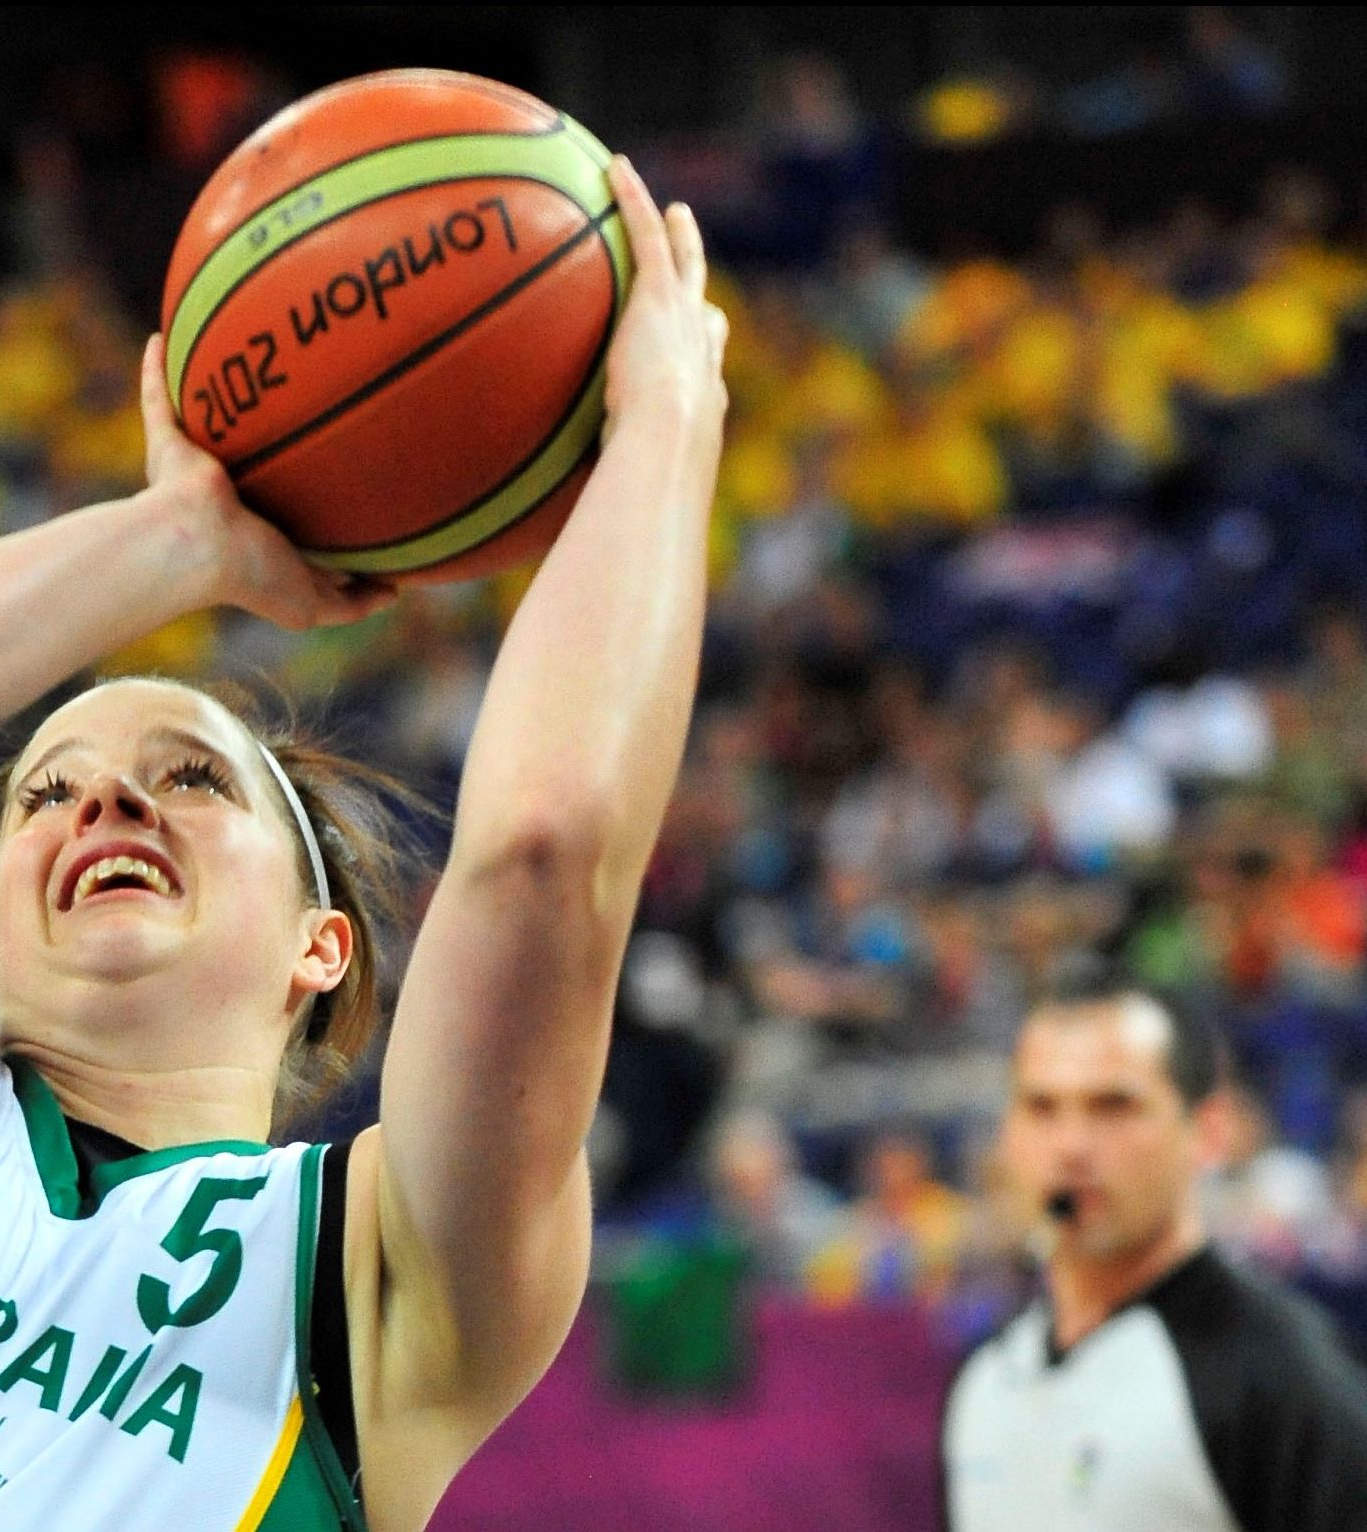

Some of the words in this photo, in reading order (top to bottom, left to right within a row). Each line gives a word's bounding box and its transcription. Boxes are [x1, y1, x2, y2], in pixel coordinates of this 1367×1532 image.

[289, 196, 518, 345] London
[194, 331, 288, 443] 2012
[136, 1170, 271, 1336] 5
